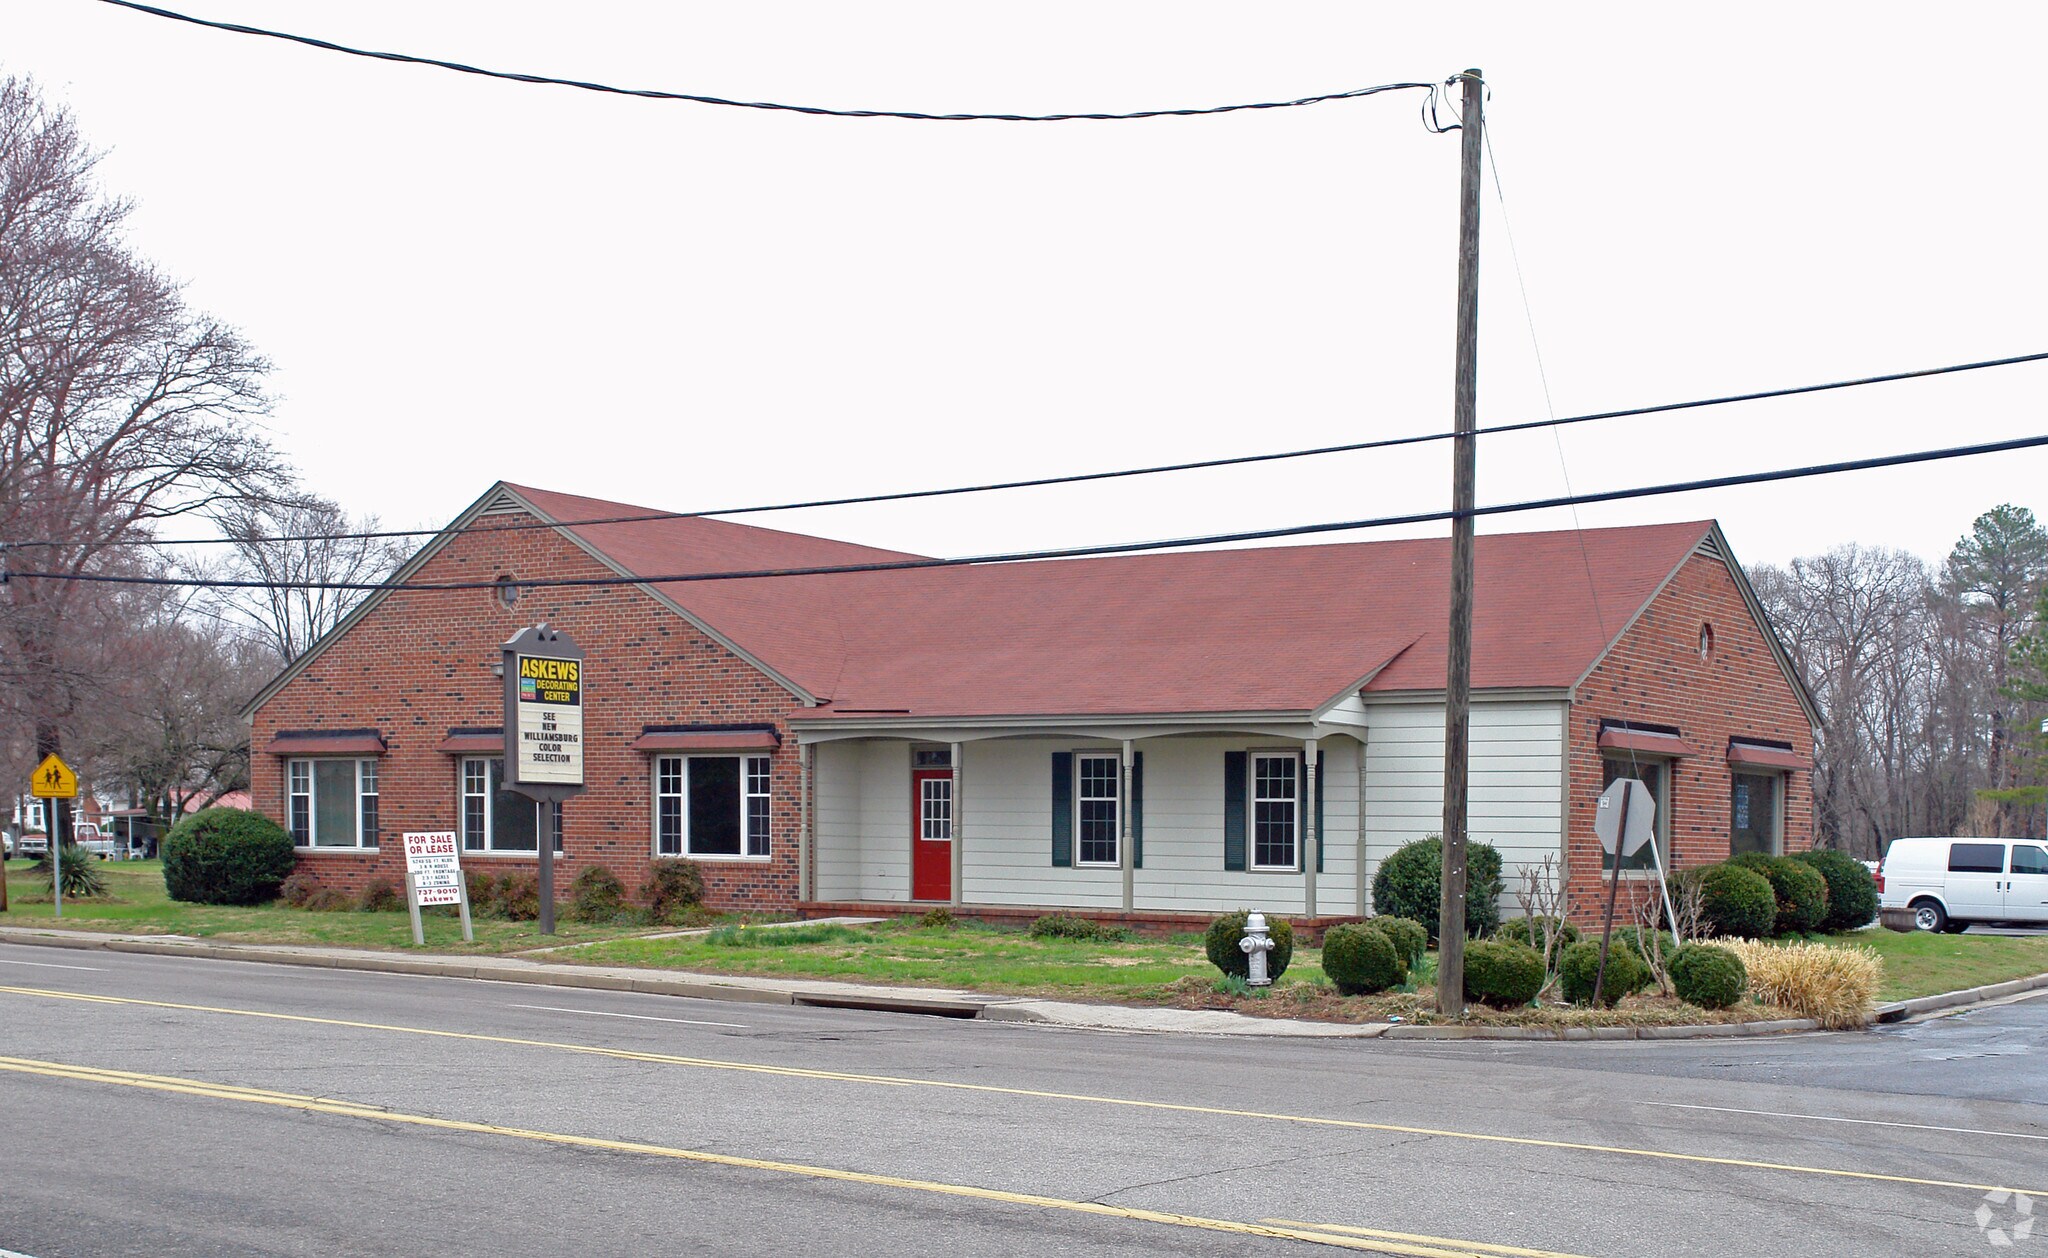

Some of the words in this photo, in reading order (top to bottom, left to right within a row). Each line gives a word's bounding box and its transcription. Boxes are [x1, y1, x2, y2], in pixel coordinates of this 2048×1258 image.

[521, 658, 578, 680] ASKEWS
[536, 679, 578, 691] DECORATING
[544, 691, 570, 702] CENTER
[543, 712, 555, 721] SEE
[542, 722, 557, 731] NEW
[524, 732, 578, 742] WILLIAMSBURG
[539, 743, 562, 752] COLOR
[533, 753, 570, 762] SELECTION
[408, 836, 426, 844] FOR
[430, 834, 452, 843] SALE
[409, 846, 422, 854] OR
[426, 844, 454, 853] LEASE
